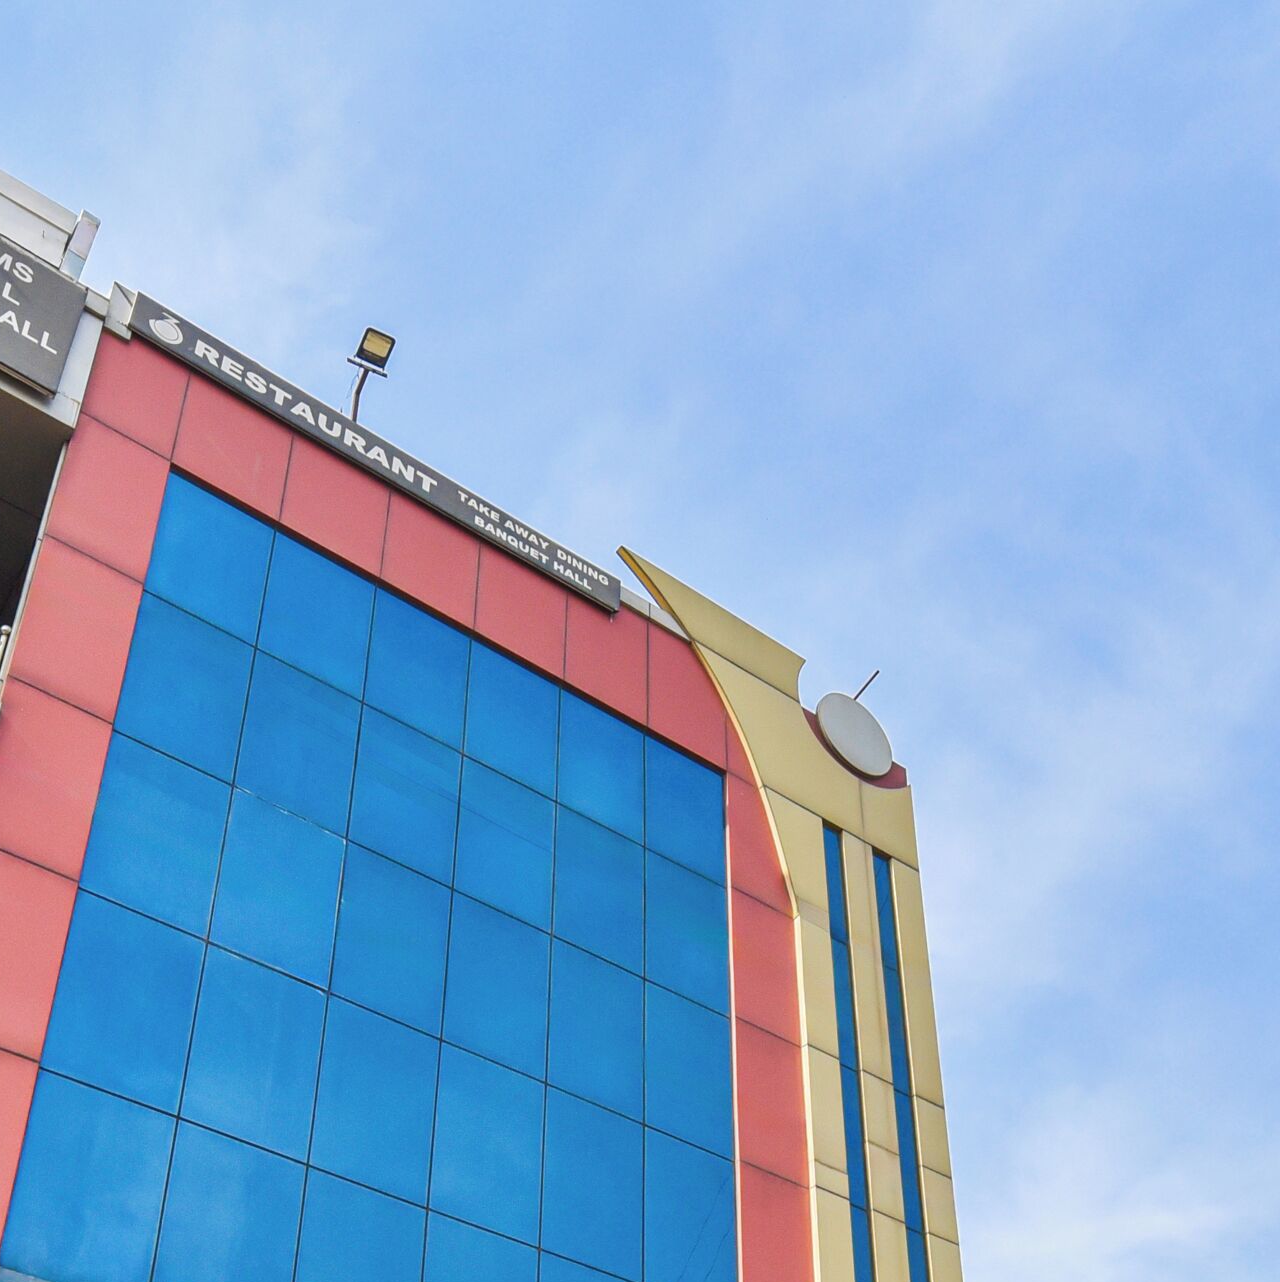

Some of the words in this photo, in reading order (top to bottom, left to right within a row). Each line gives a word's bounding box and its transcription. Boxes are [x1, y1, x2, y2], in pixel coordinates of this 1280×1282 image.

[194, 338, 438, 495] RESTAURANT
[457, 490, 501, 523] TAKE
[504, 519, 550, 550] AWAY
[556, 548, 609, 586] DINING
[474, 515, 550, 565] BANQUET
[553, 560, 593, 591] HALL
